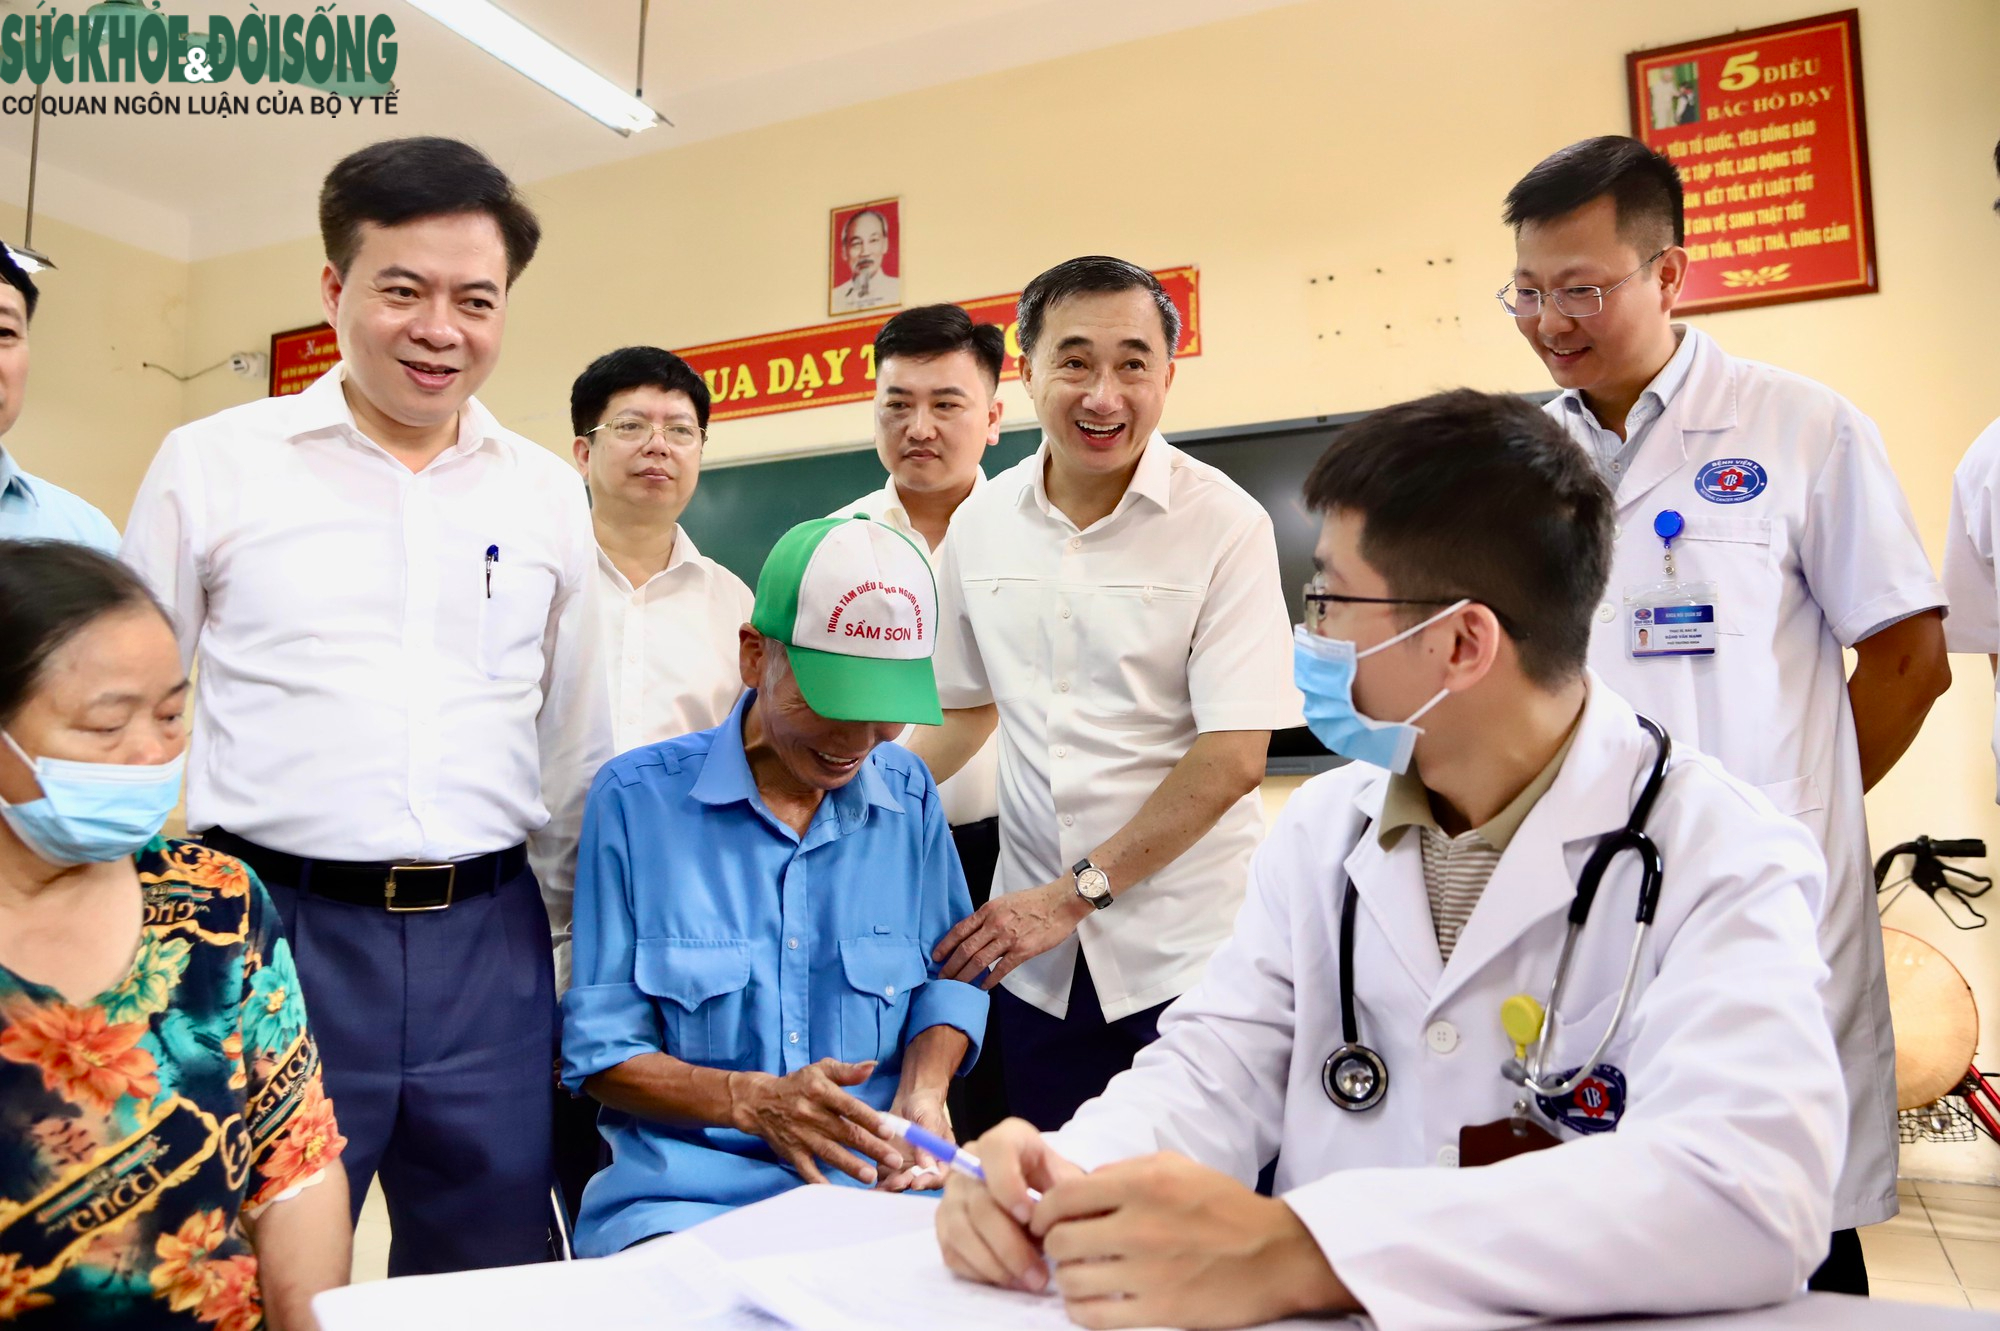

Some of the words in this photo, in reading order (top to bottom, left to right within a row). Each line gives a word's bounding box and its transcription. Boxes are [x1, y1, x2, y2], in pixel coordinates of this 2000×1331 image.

[1719, 50, 1760, 91] 5
[1763, 57, 1821, 84] ĐIỀU
[1706, 100, 1749, 121] BÁC
[1753, 91, 1786, 113] HỒ
[1789, 85, 1834, 107] DẠY
[703, 364, 758, 404] UA
[766, 347, 852, 399] DẠY
[827, 605, 844, 633] TRUNG
[844, 619, 880, 640] SẦM
[884, 626, 912, 641] SƠN
